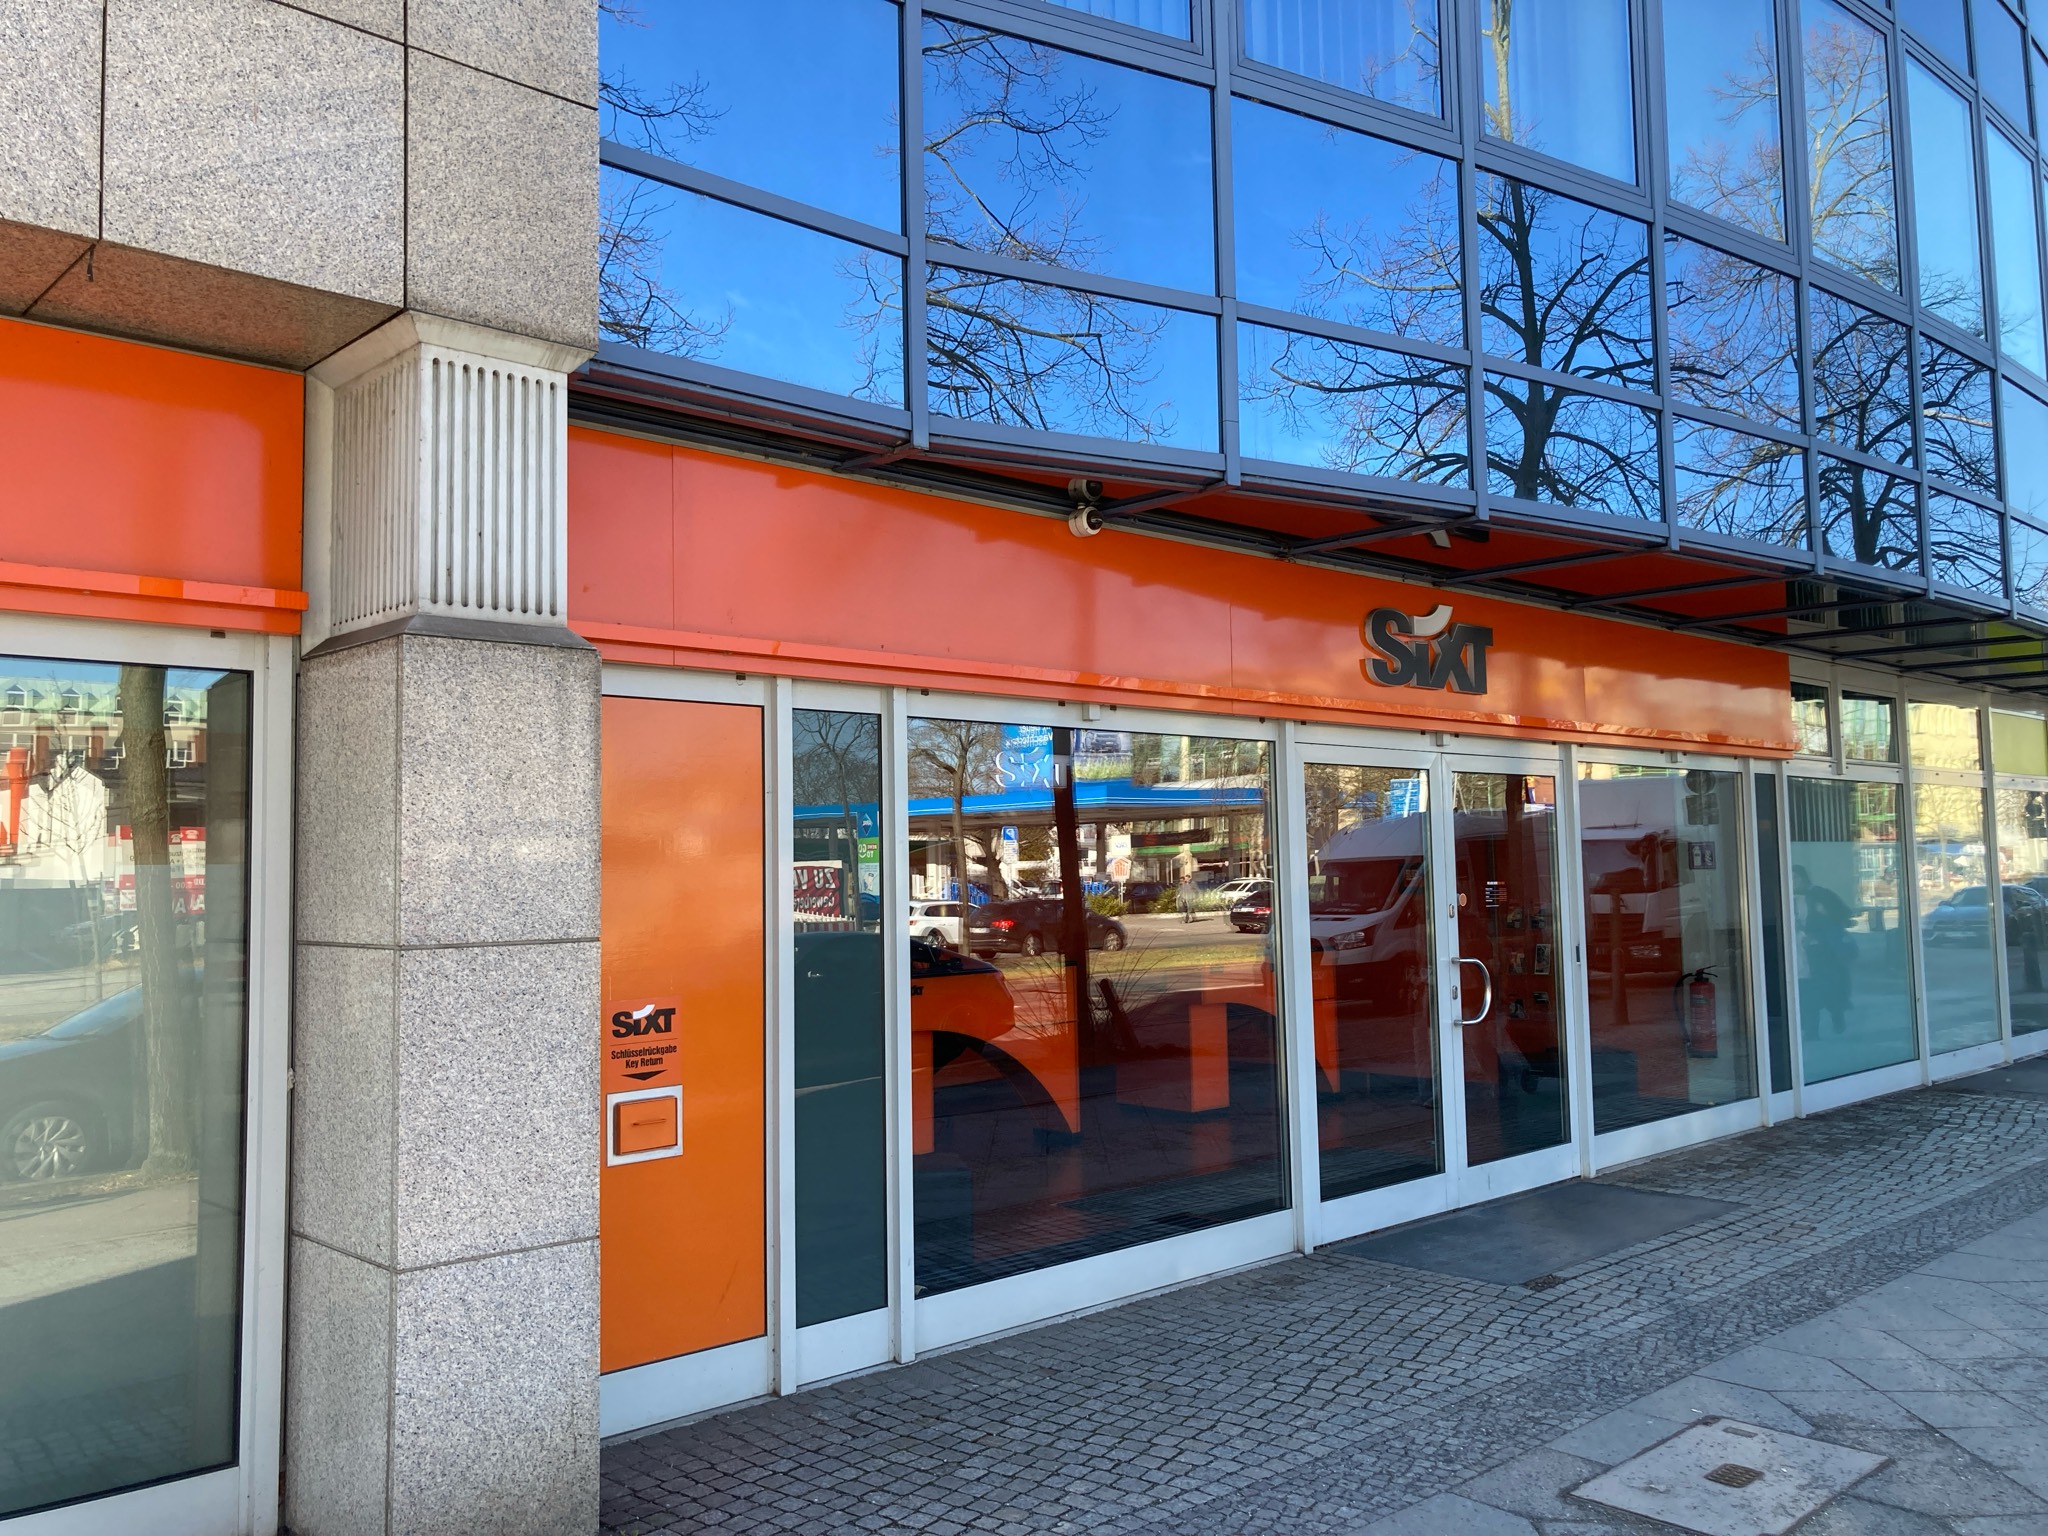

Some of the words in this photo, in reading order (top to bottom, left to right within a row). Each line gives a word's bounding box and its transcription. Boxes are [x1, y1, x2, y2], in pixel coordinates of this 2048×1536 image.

[611, 1044, 677, 1060] Schlüsselrückgabe
[625, 1058, 639, 1069] Key
[640, 1056, 664, 1068] Return
